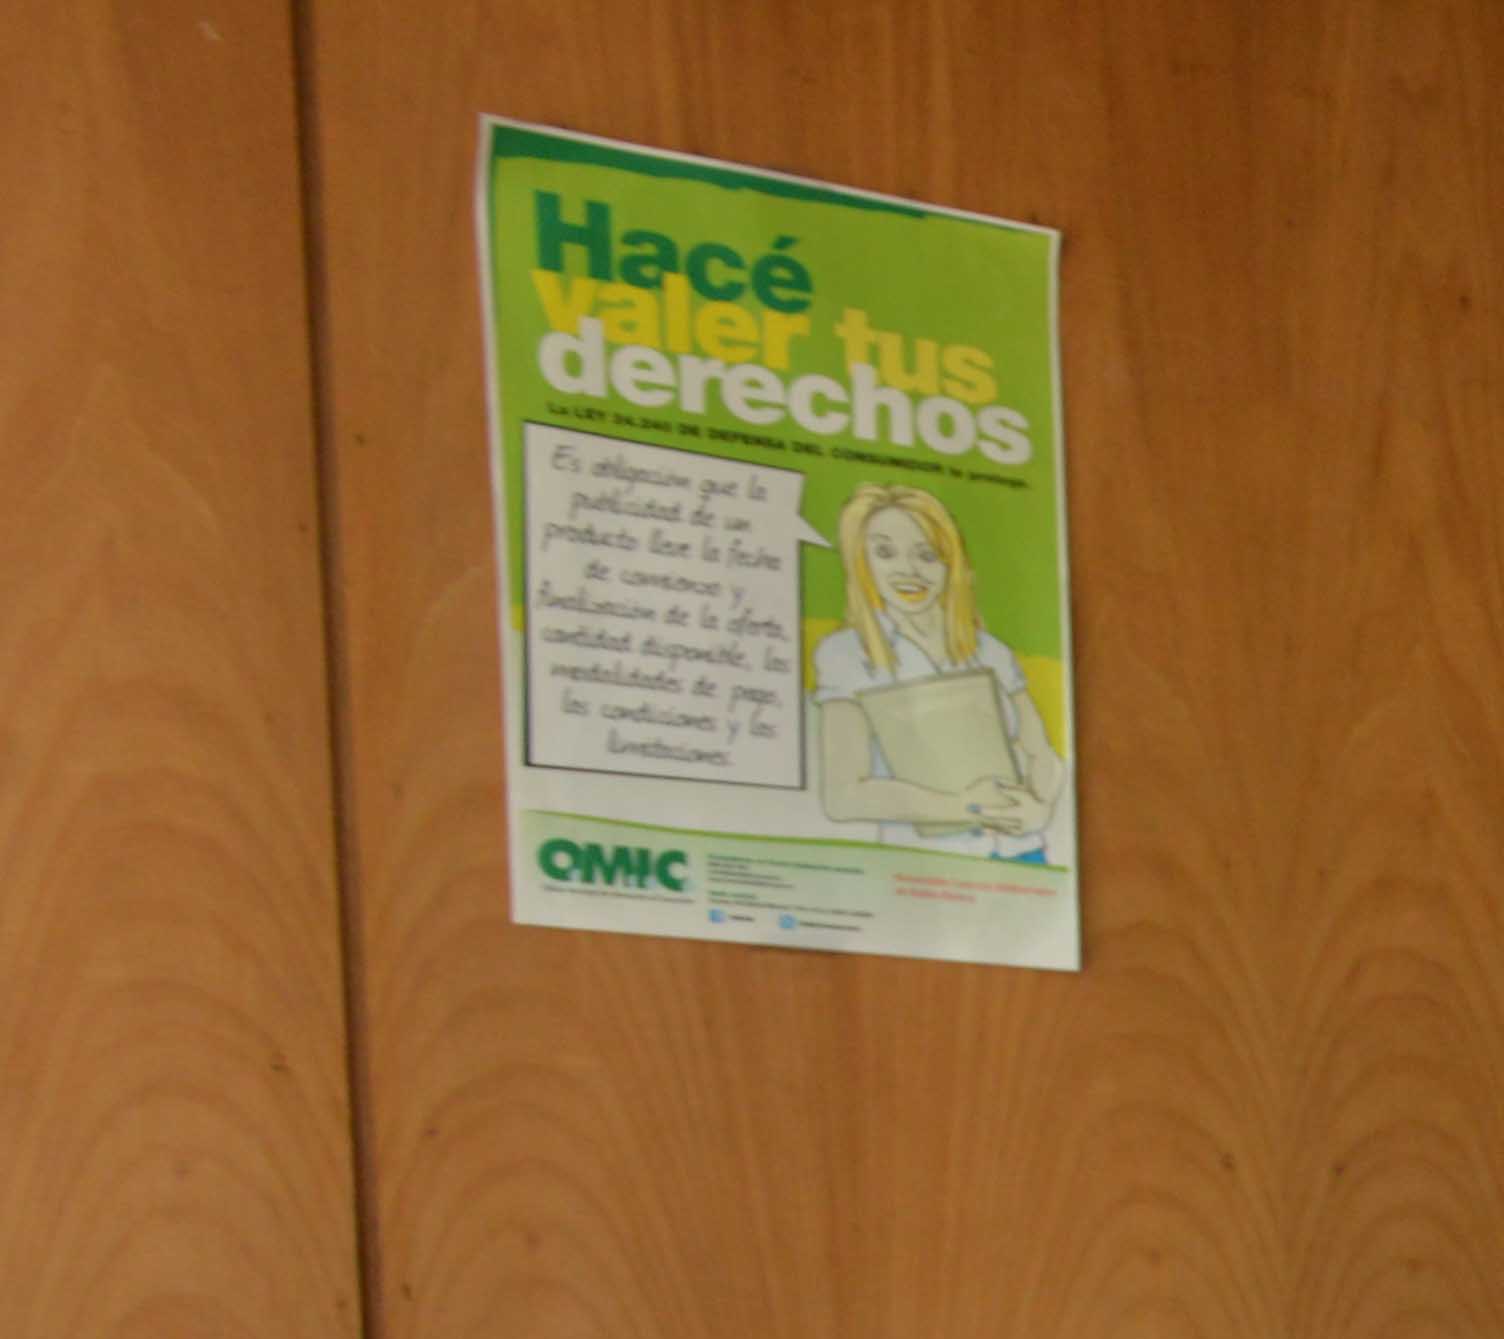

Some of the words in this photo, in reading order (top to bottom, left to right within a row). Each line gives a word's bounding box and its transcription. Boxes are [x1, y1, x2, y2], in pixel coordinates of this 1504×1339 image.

[534, 190, 813, 312] Hacé
[530, 270, 811, 369] valer
[835, 308, 998, 406] tus
[538, 314, 1032, 466] derechos
[537, 838, 690, 891] OMIC
